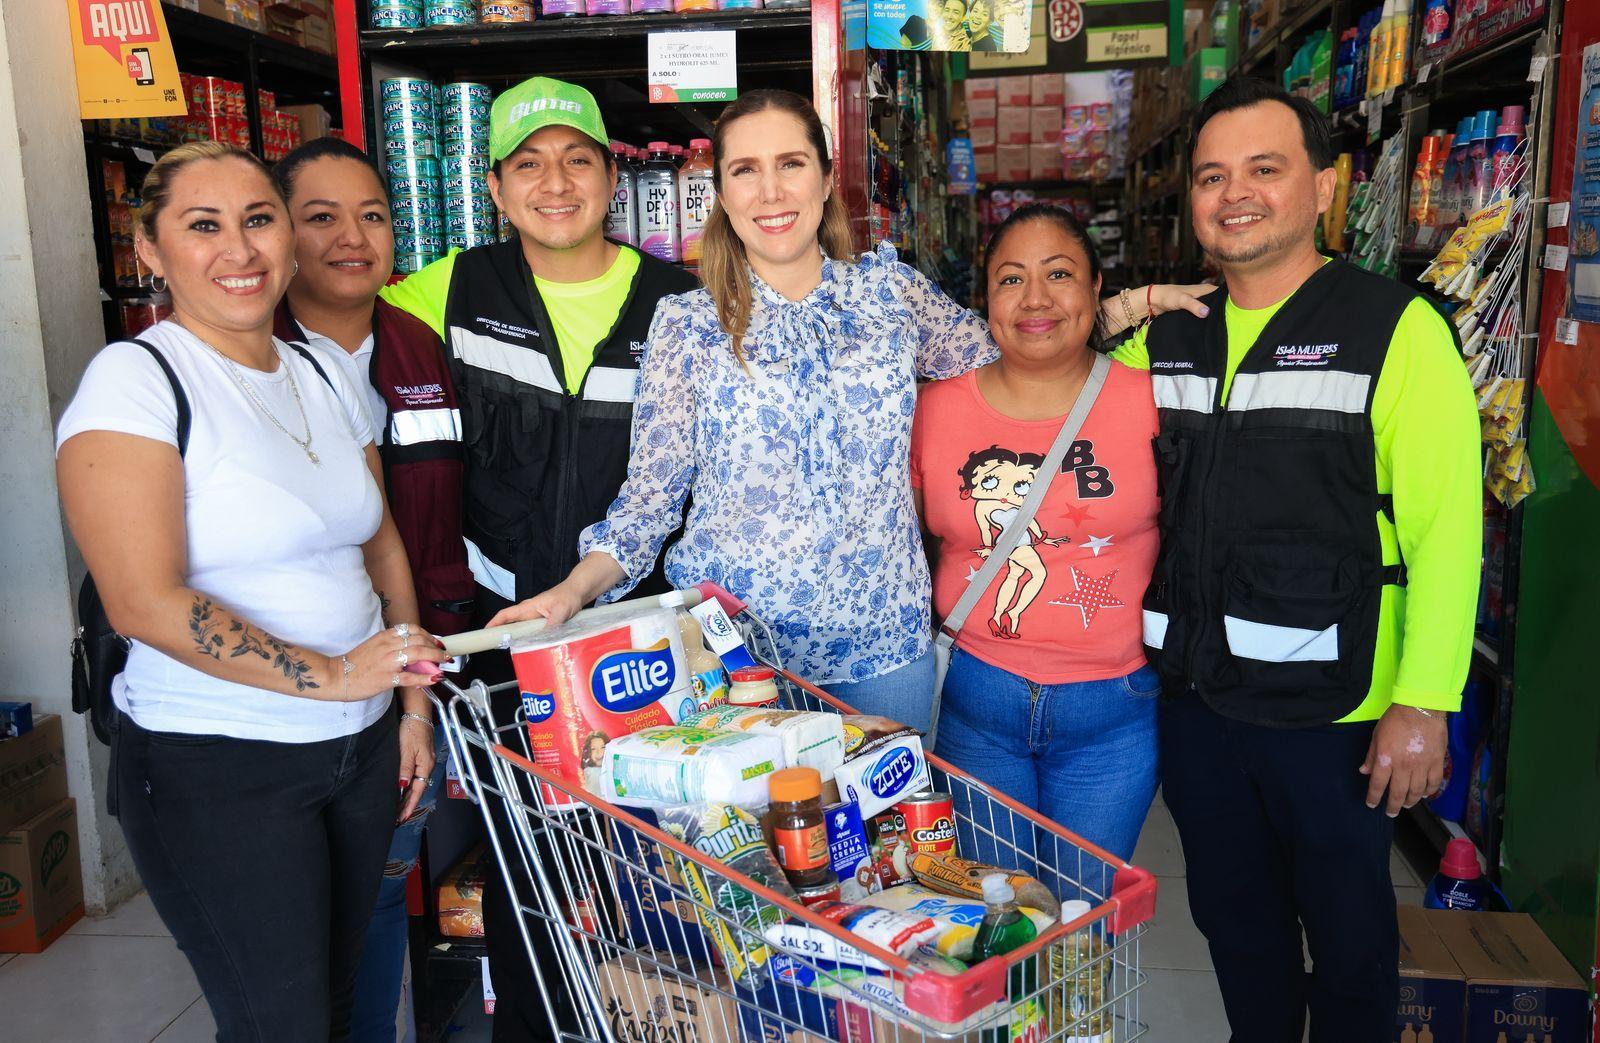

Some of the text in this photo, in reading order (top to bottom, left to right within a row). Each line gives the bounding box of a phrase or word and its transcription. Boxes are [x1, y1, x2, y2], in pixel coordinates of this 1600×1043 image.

[886, 12, 907, 20] todos
[649, 189, 667, 201] HY
[688, 183, 706, 196] HY
[601, 655, 672, 704] Elite
[524, 696, 552, 717] Elite
[624, 708, 661, 727] Cuidado
[872, 748, 914, 796] ZOTE
[938, 819, 948, 830] La
[831, 836, 861, 853] MEDIA
[833, 844, 863, 861] CREMA
[780, 936, 800, 951] SAL
[1493, 1009, 1555, 1033] Downy
